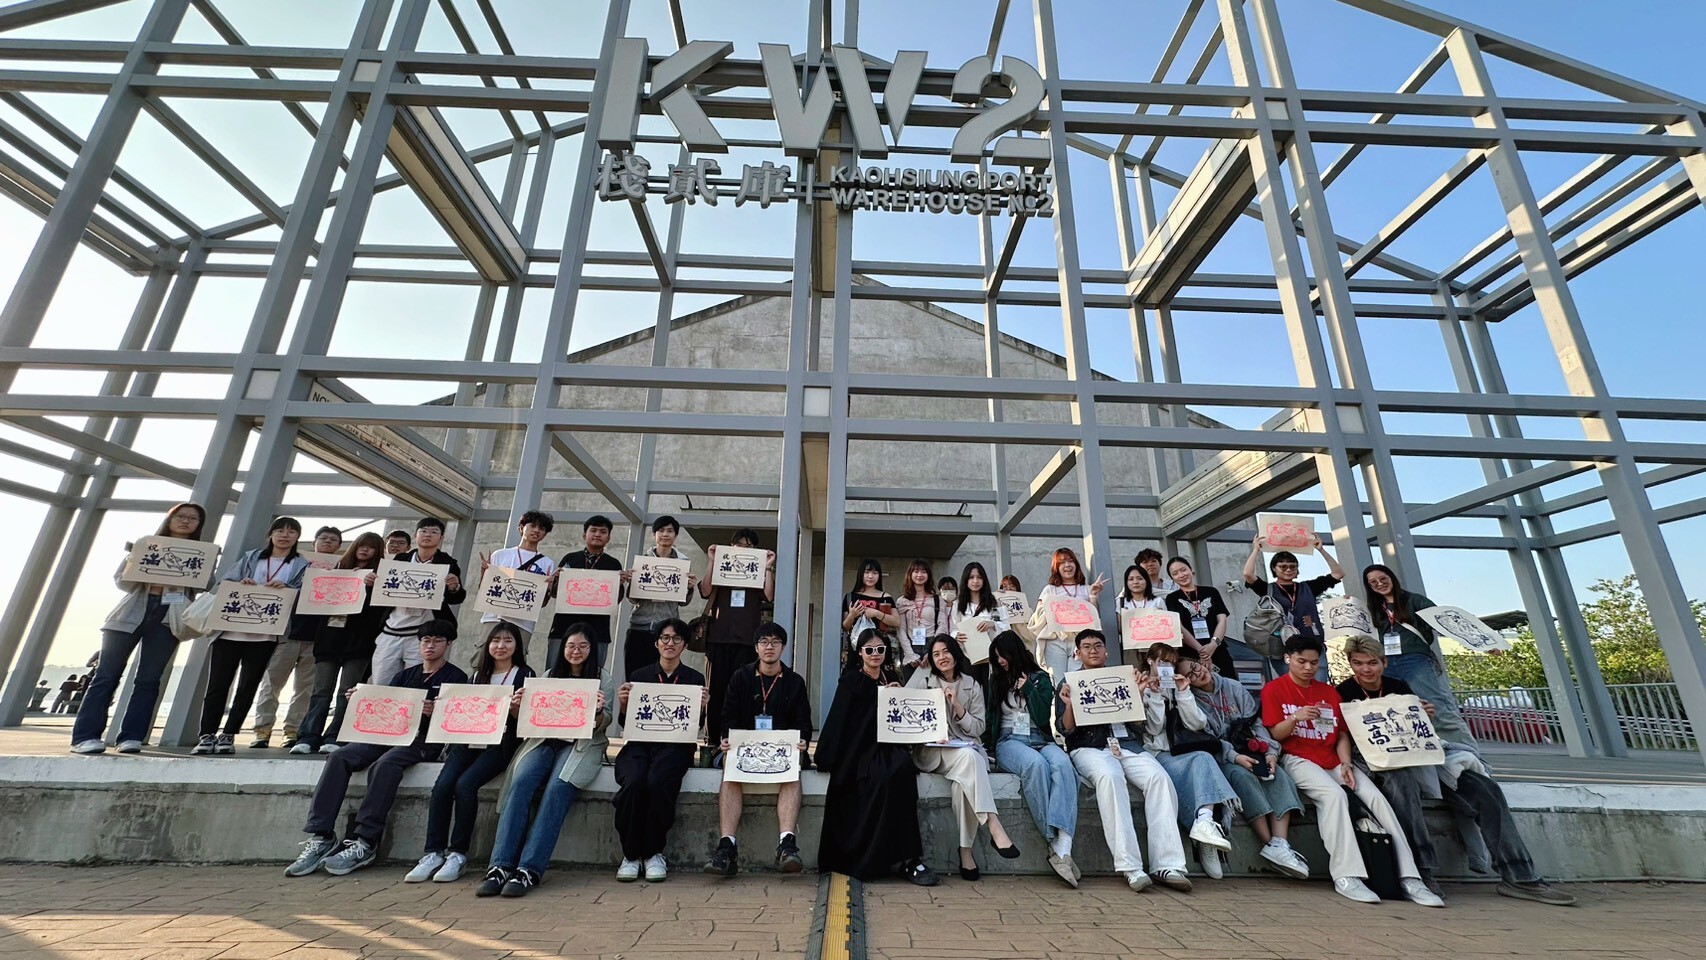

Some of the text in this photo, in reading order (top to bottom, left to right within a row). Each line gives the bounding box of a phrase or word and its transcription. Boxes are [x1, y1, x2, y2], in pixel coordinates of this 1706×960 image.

[597, 36, 1051, 167] KW2
[830, 165, 1053, 196] KAOHSIUNG PORT
[829, 186, 1001, 216] WAREHOUSE
[1368, 720, 1434, 745] 高 雄
